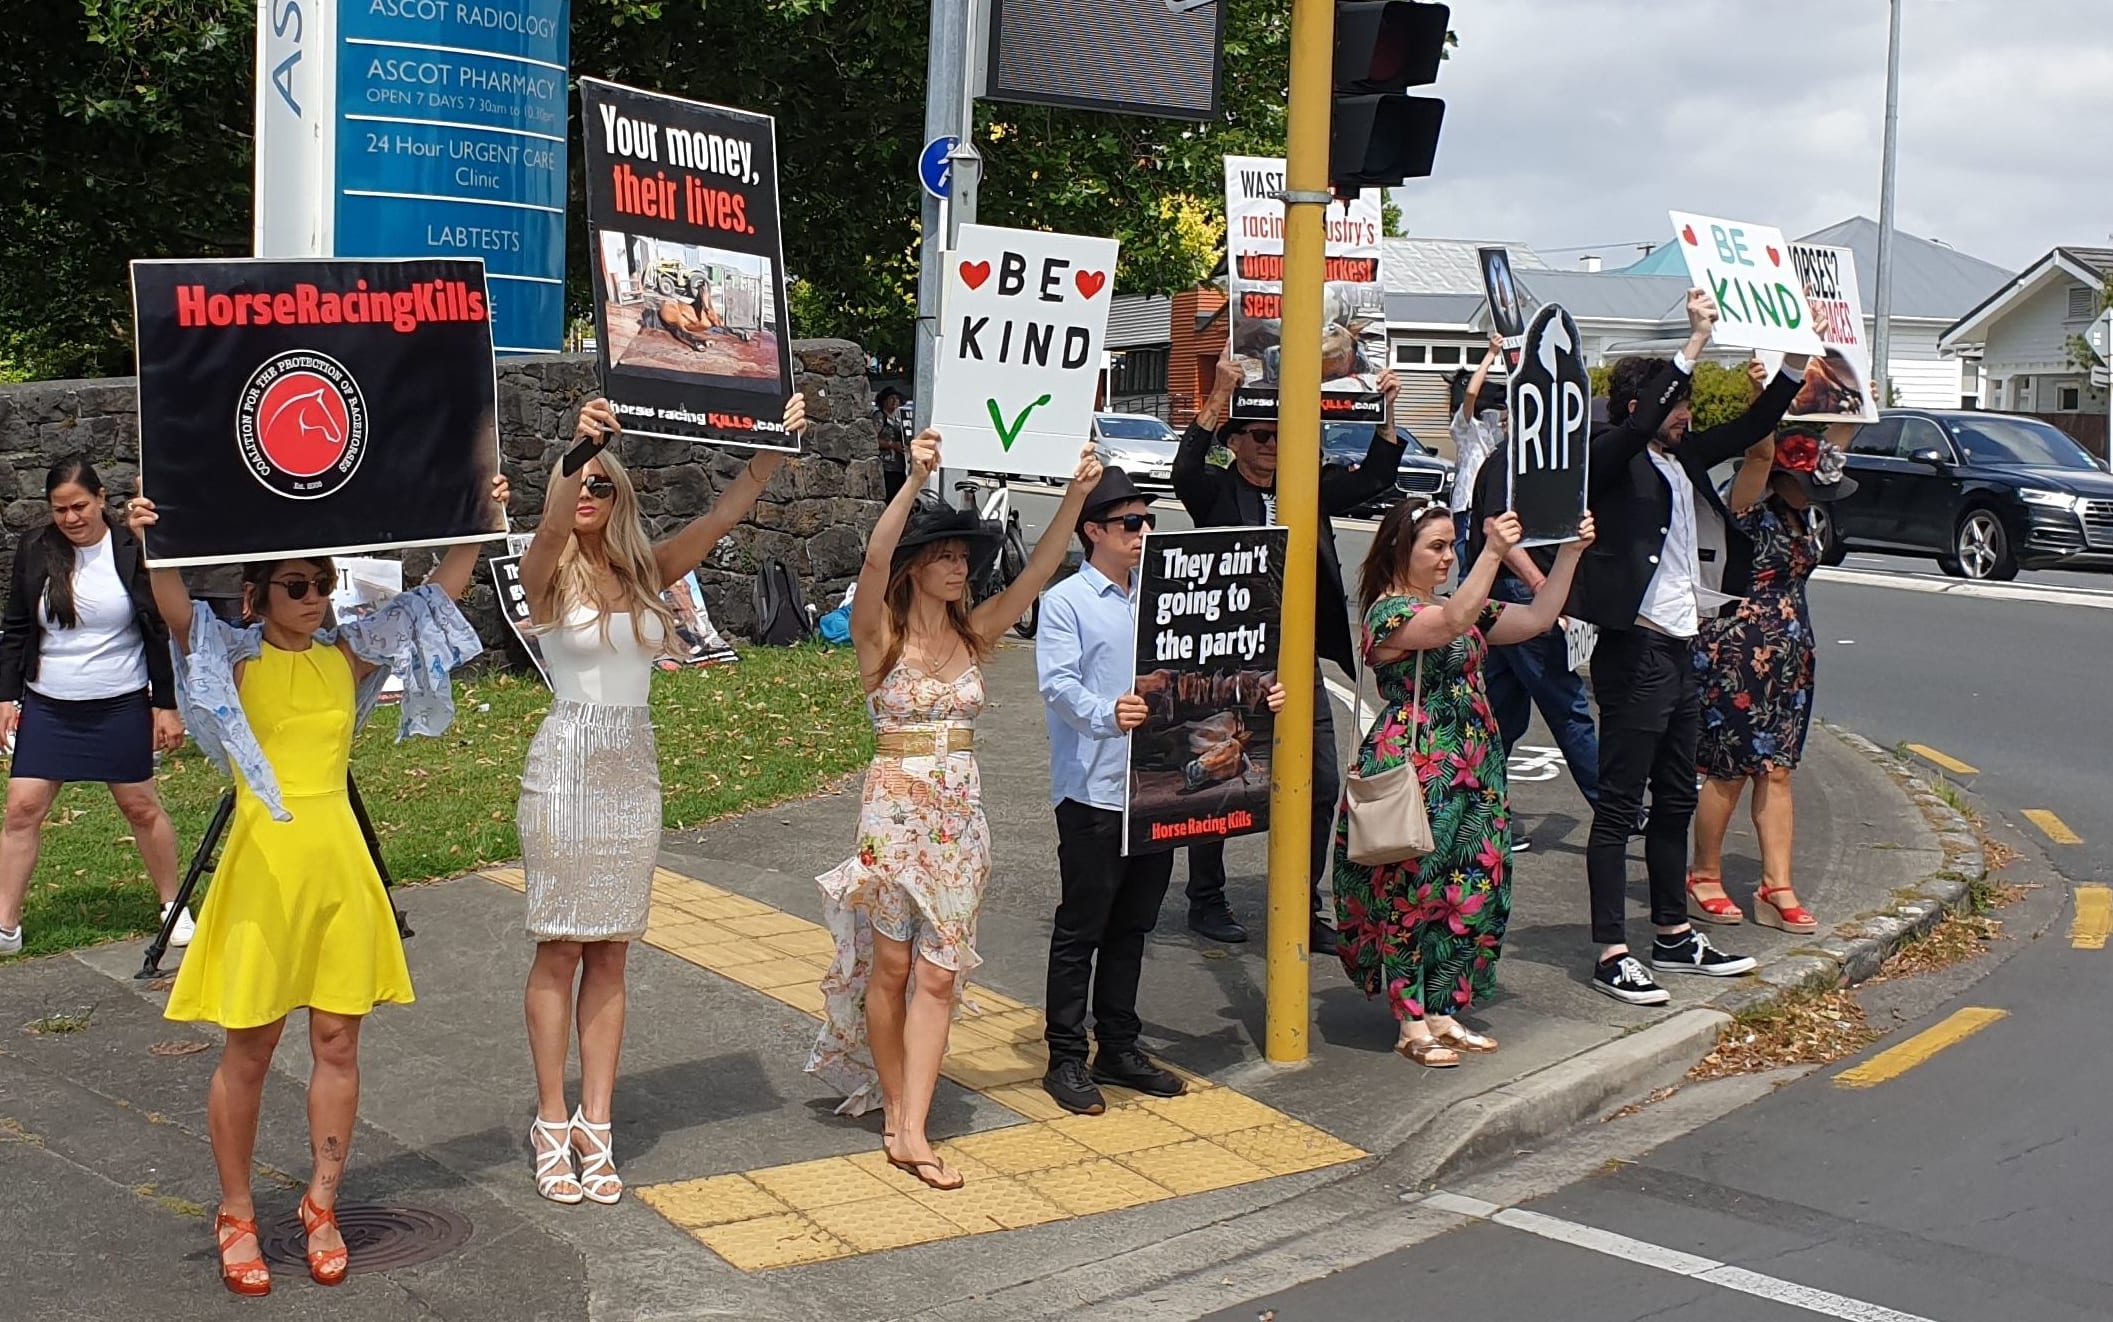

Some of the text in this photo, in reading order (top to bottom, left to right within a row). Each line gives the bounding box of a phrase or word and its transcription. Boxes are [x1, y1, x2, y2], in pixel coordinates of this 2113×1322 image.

[369, 0, 556, 39] ASCOT RADIOLOGY
[366, 58, 556, 100] ASCOT PHARMACY
[366, 88, 411, 105] OPEN
[416, 91, 425, 105] 7
[429, 93, 464, 110] DAYS
[510, 105, 520, 117] to
[366, 133, 555, 171] 24 Hour URGENT CARE
[599, 103, 760, 186] Your money,
[455, 167, 499, 189] Clinic
[1240, 170, 1284, 199] WAST
[613, 164, 756, 235] their lives.
[427, 224, 520, 252] LABTESTS
[1242, 212, 1375, 246] racin ustry's
[1710, 224, 1755, 267] BE
[998, 251, 1070, 303] BE
[1243, 249, 1373, 282] bigg arkest
[1244, 293, 1282, 319] secr
[1706, 268, 1802, 330] KIND
[959, 316, 1091, 369] KIND
[255, 366, 278, 389] THE
[277, 357, 343, 382] PROTECTION
[340, 380, 354, 395] OF
[244, 388, 261, 412] FOR
[609, 400, 655, 418] horse
[657, 408, 706, 425] racing
[1237, 395, 1275, 408] horse
[242, 414, 271, 476] COALITION
[1518, 381, 1585, 475] RIP
[1163, 542, 1269, 585] They ain't
[1156, 581, 1251, 625] going to
[1155, 622, 1266, 665] the party!
[1151, 810, 1252, 840] Horse Racing Kills
